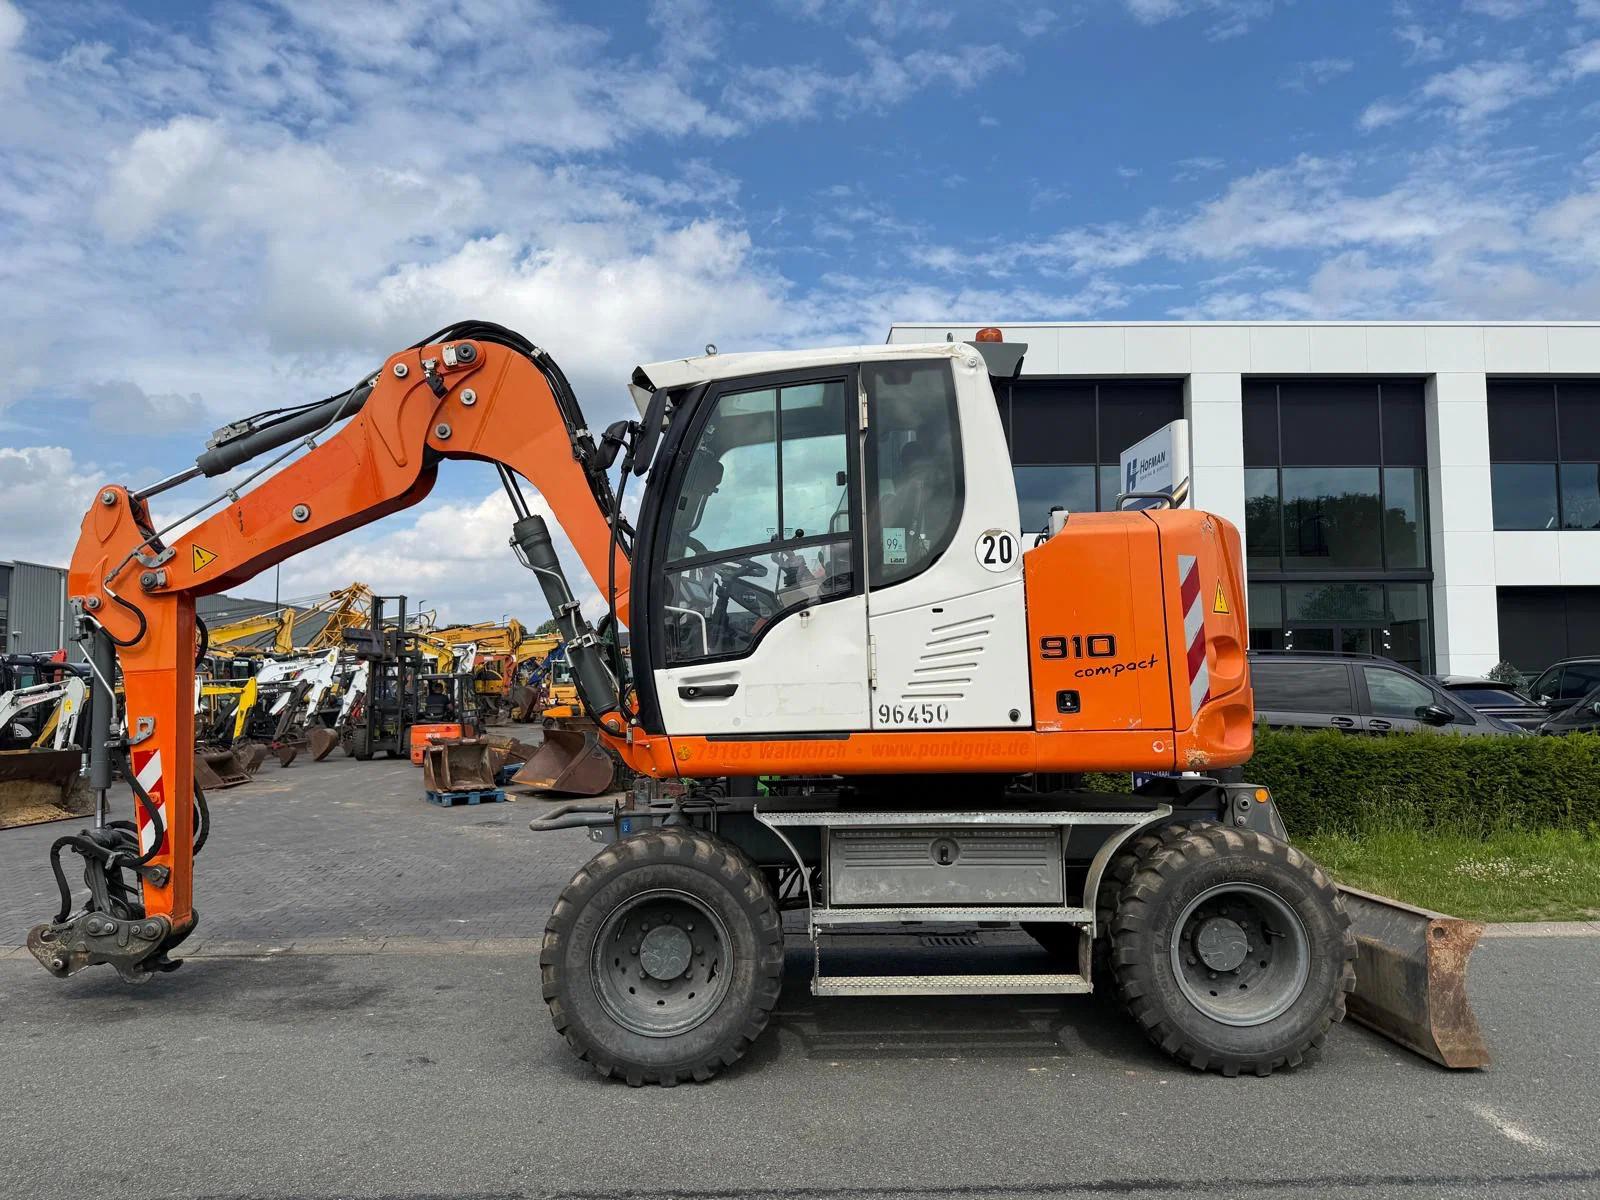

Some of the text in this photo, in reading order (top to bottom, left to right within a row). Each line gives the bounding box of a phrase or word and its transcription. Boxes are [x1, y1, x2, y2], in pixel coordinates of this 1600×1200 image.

[1139, 450, 1166, 474] HOFMAN
[886, 538, 898, 549] 99
[982, 534, 1012, 565] 20
[1040, 634, 1117, 660] 910
[1074, 653, 1159, 678] compact
[878, 704, 949, 725] 96450
[696, 739, 1029, 761] 79183 Waldkirch www.pontiggia.de
